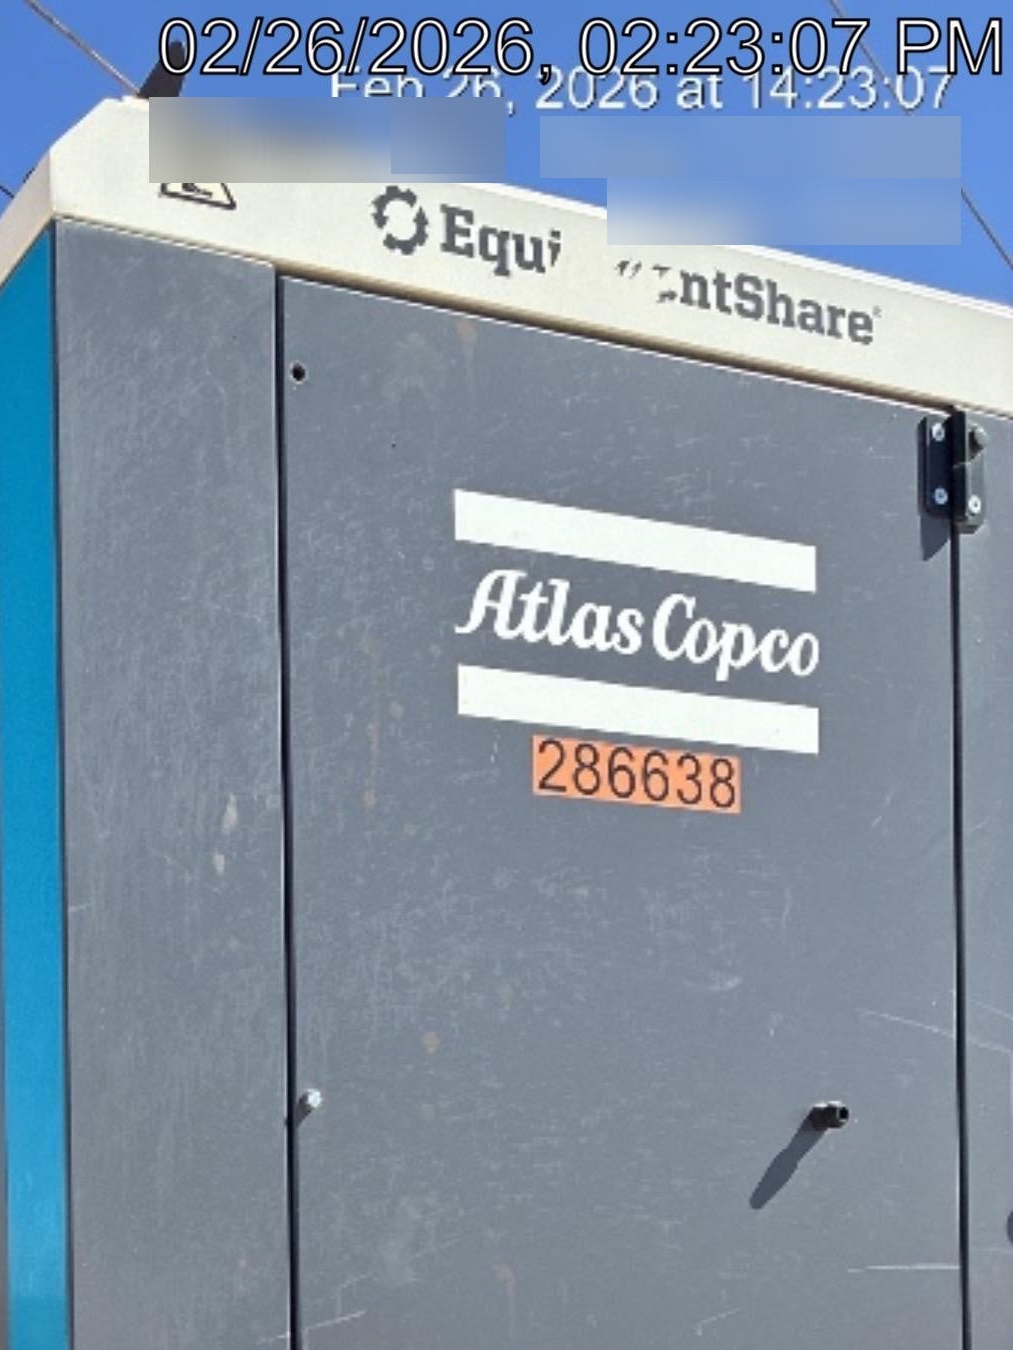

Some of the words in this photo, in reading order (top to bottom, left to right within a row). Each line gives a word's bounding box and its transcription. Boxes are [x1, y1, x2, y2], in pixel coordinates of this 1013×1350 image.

[440, 204, 874, 345] EquintShare
[455, 569, 645, 655] Atlas
[653, 593, 819, 682] Copco
[537, 739, 736, 813] 286638
